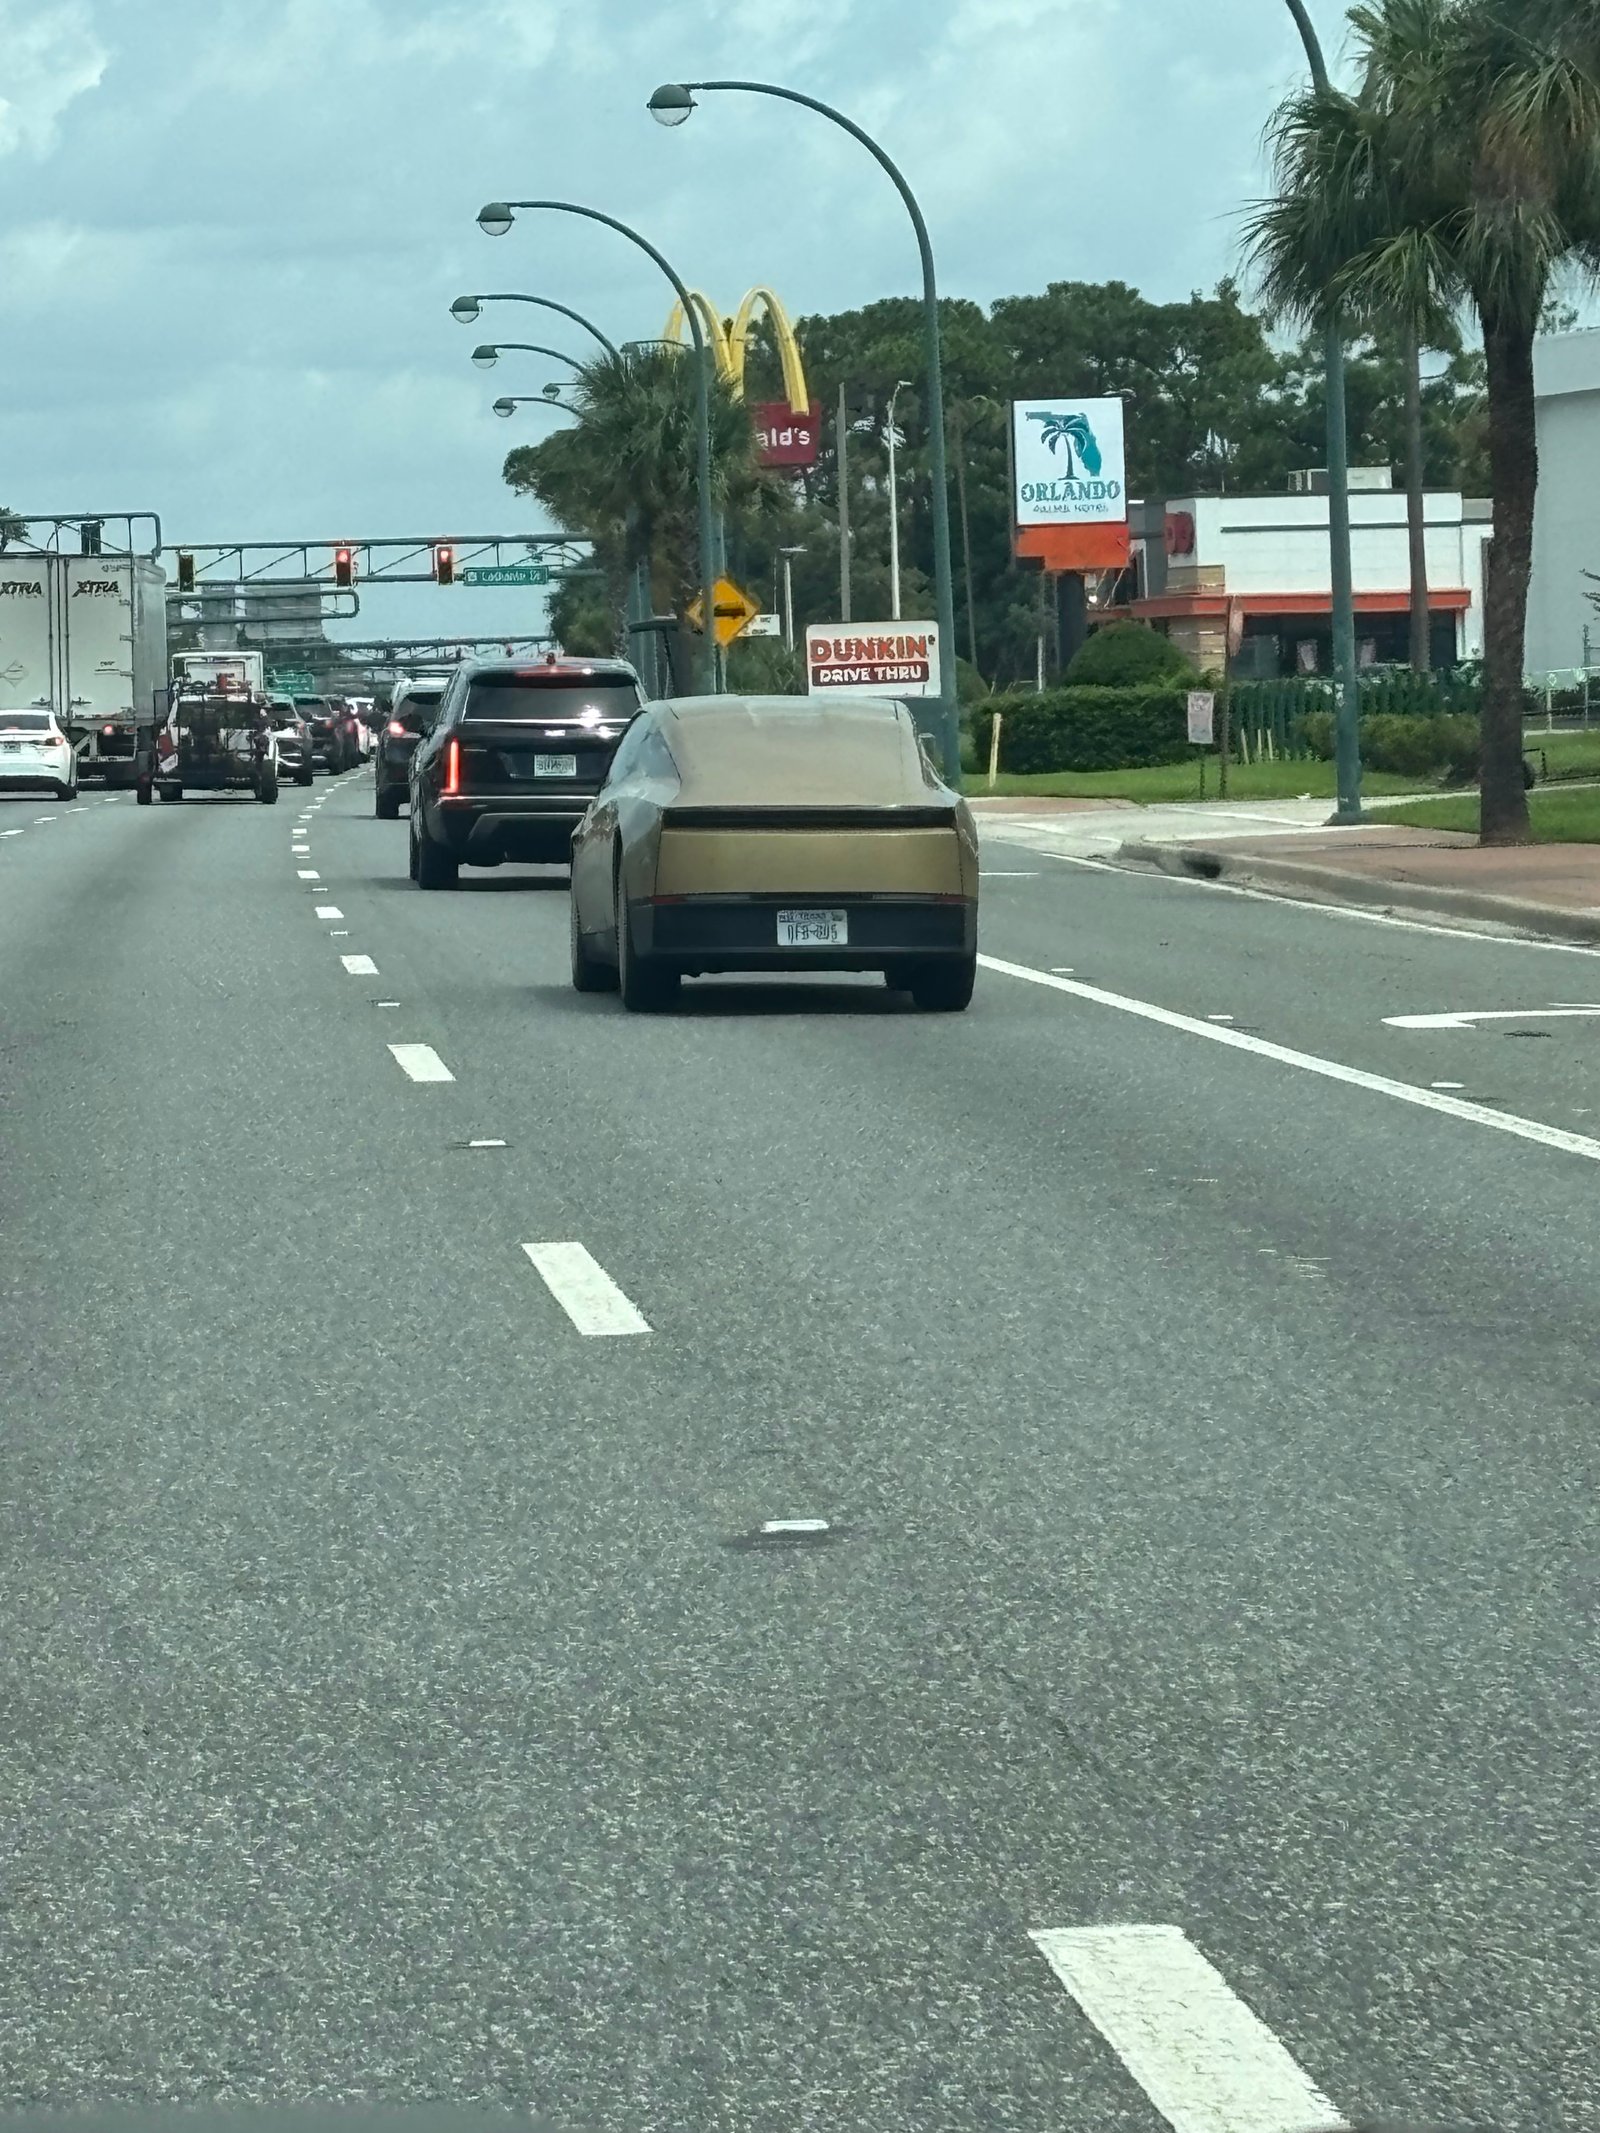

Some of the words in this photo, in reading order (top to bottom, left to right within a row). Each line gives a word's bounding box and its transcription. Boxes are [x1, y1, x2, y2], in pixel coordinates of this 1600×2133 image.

[756, 427, 810, 447] ald's
[1021, 480, 1121, 502] ORLANDO
[0, 581, 42, 597] XTRA
[72, 580, 120, 598] XTRA
[820, 667, 871, 682] DRIVE
[874, 665, 922, 680] THRU
